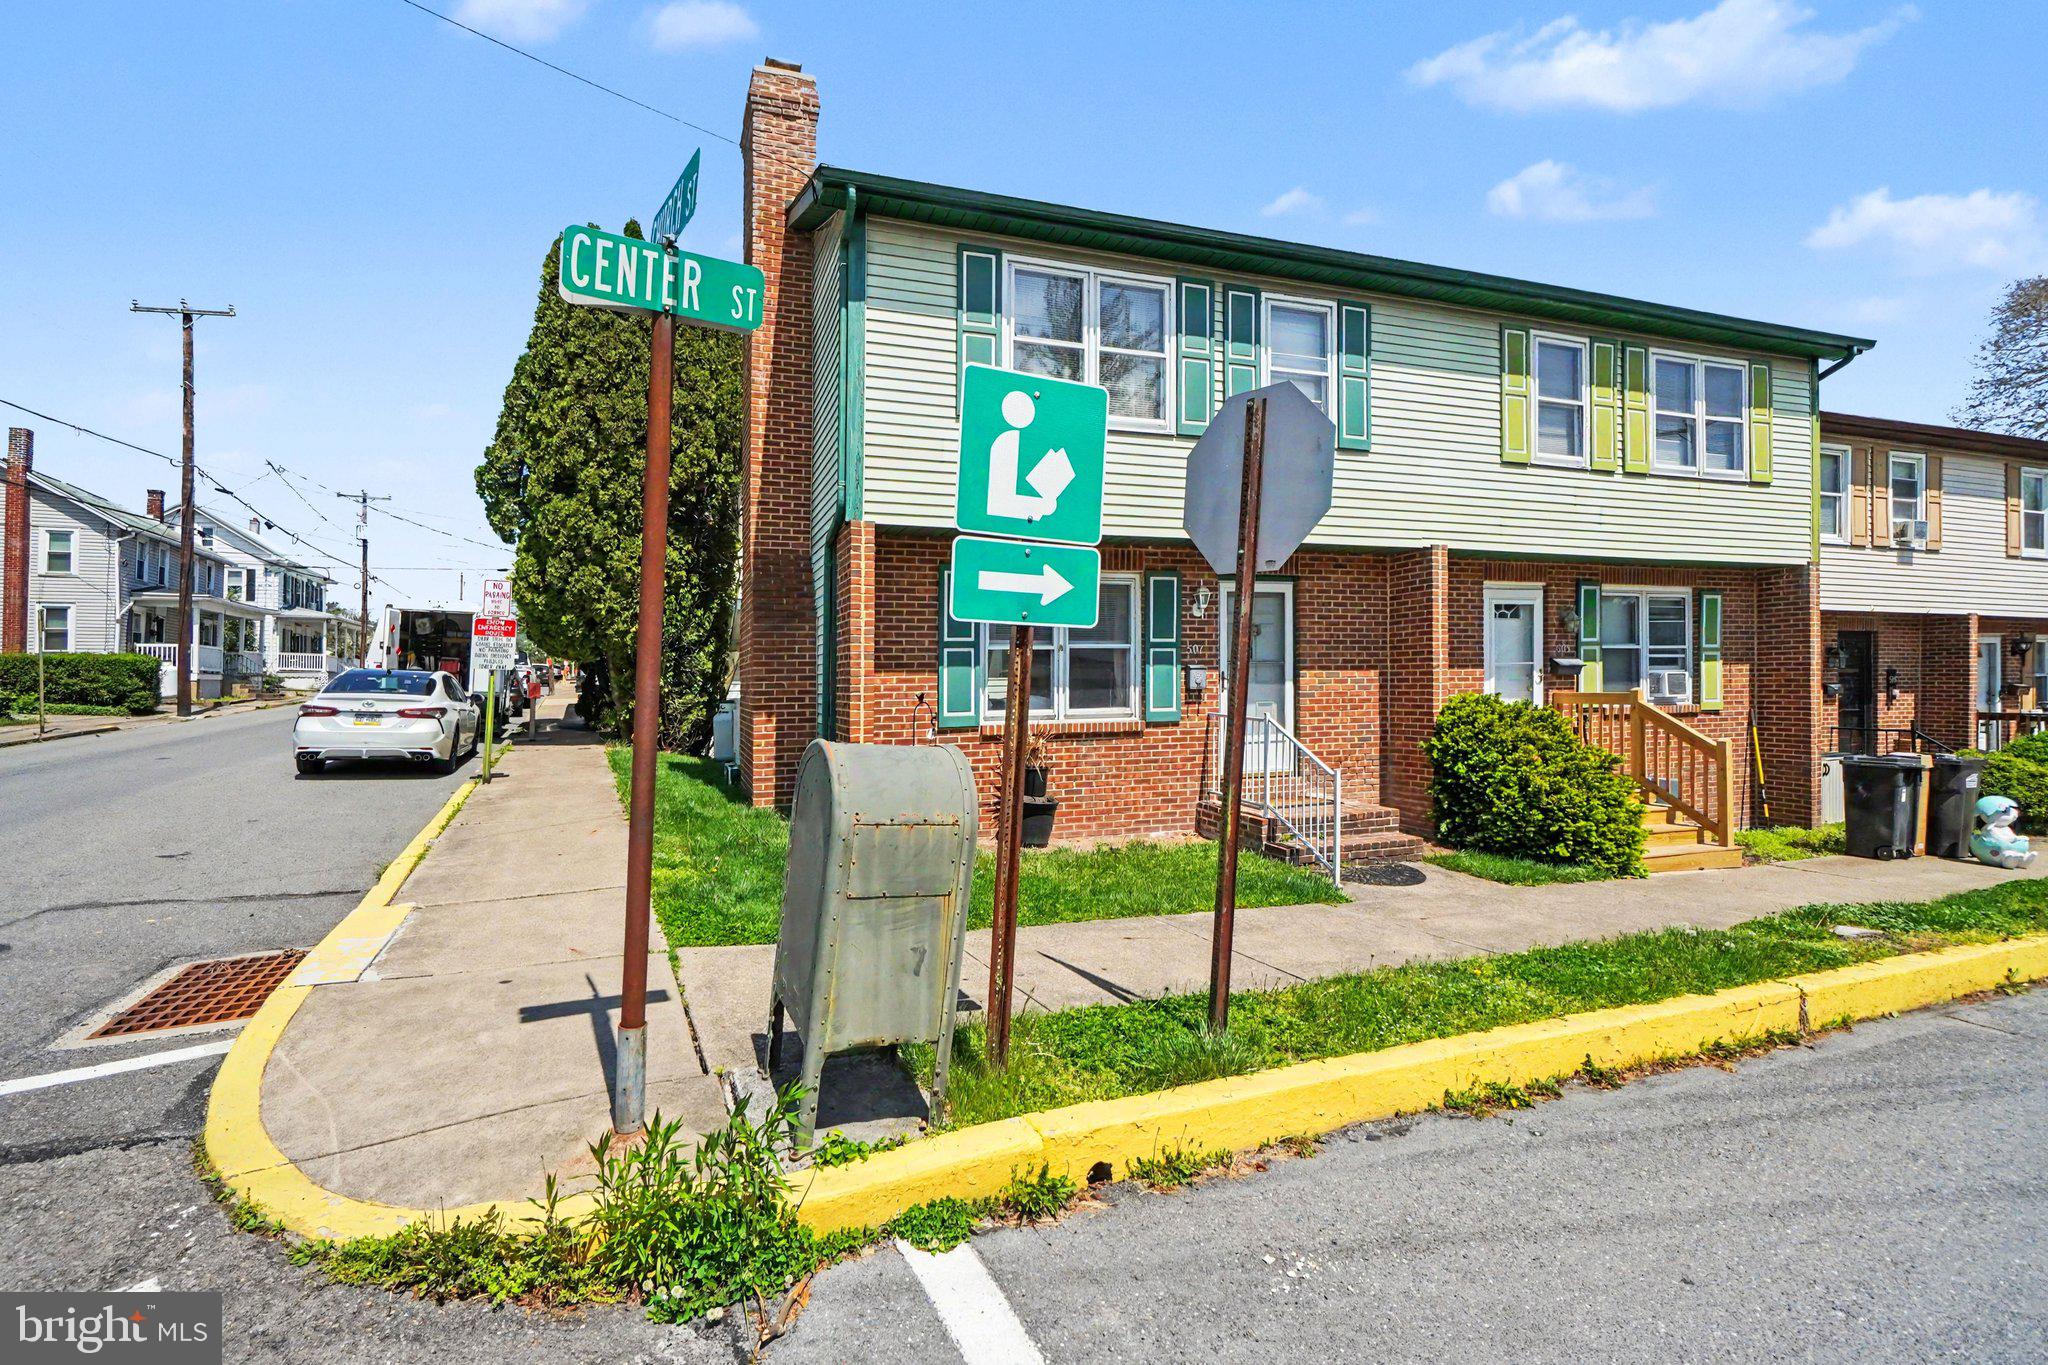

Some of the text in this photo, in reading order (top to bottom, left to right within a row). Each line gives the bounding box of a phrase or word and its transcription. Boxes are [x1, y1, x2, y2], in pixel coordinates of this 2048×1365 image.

[685, 171, 698, 217] ST
[570, 232, 757, 322] CENTER ST
[484, 591, 511, 600] PARKING
[493, 582, 503, 590] NO
